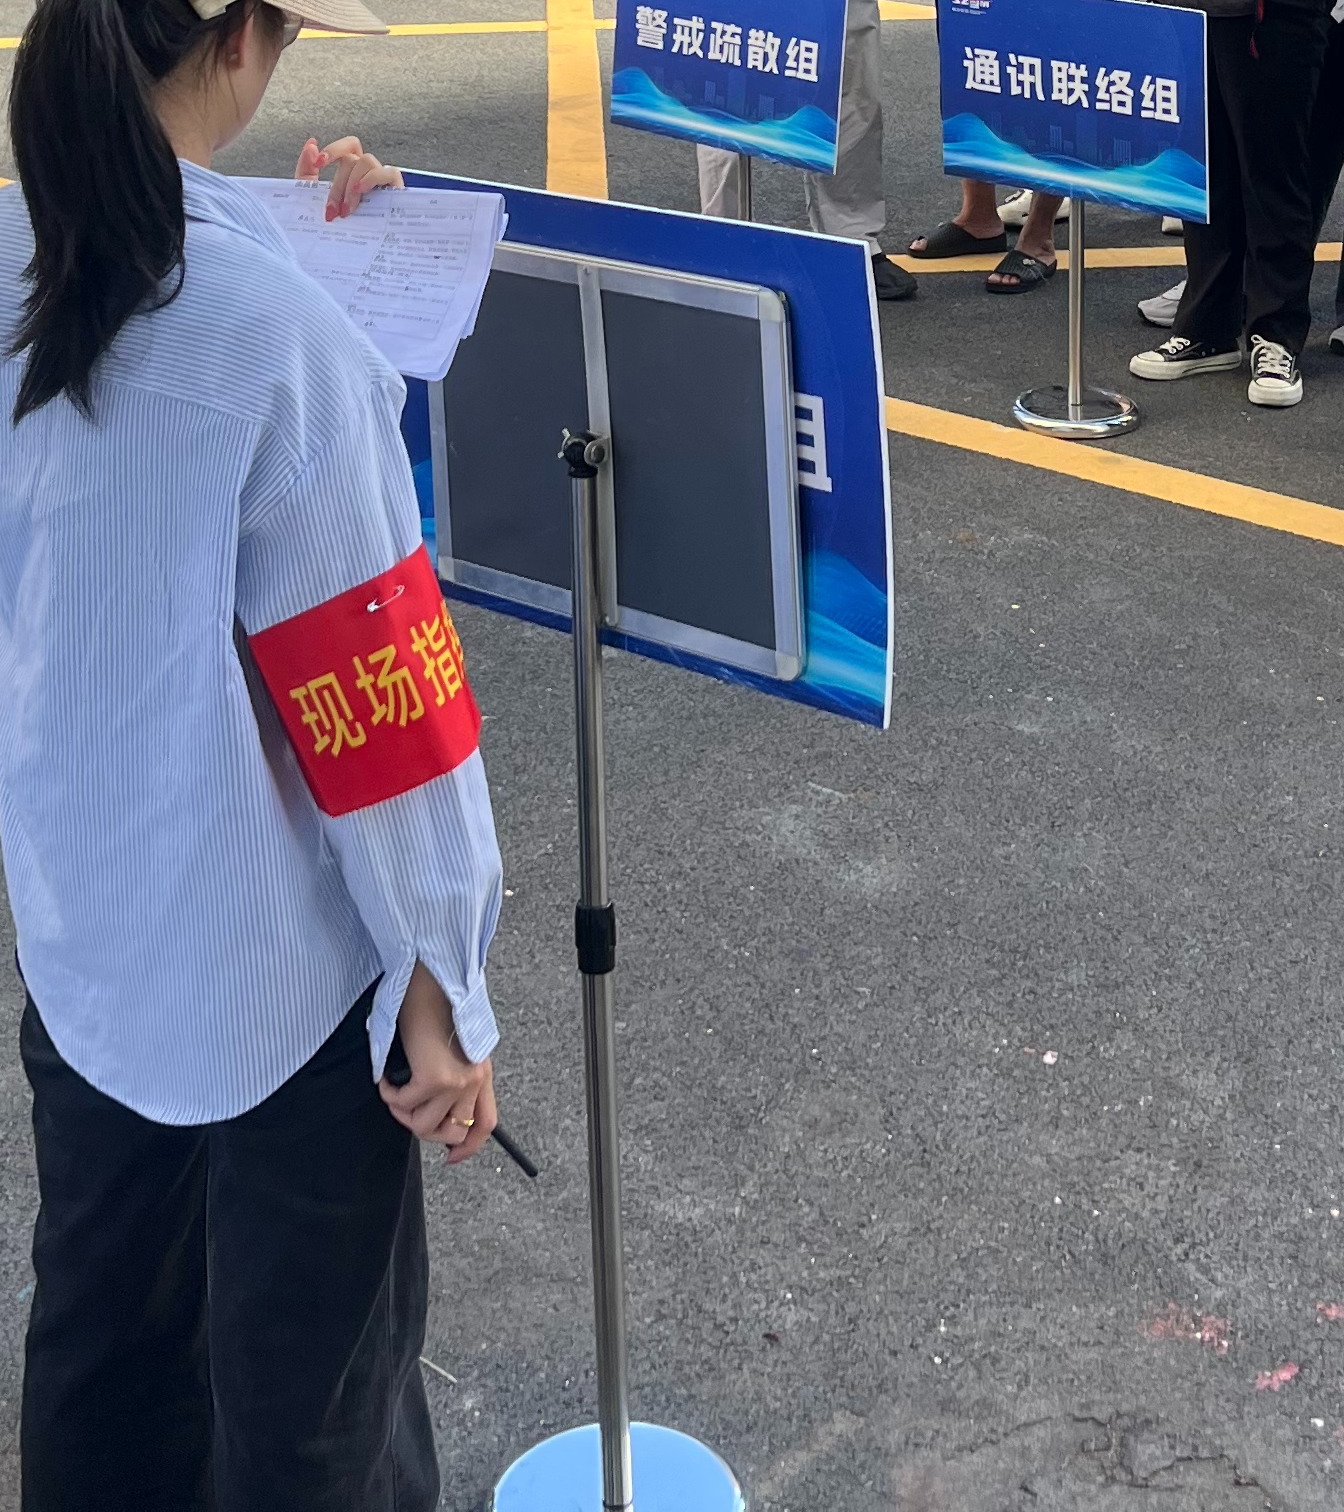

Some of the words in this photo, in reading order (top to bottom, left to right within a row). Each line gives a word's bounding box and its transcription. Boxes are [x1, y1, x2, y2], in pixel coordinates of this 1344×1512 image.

[635, 5, 819, 83] 警戒疏散组
[962, 46, 1180, 124] 通讯联络组
